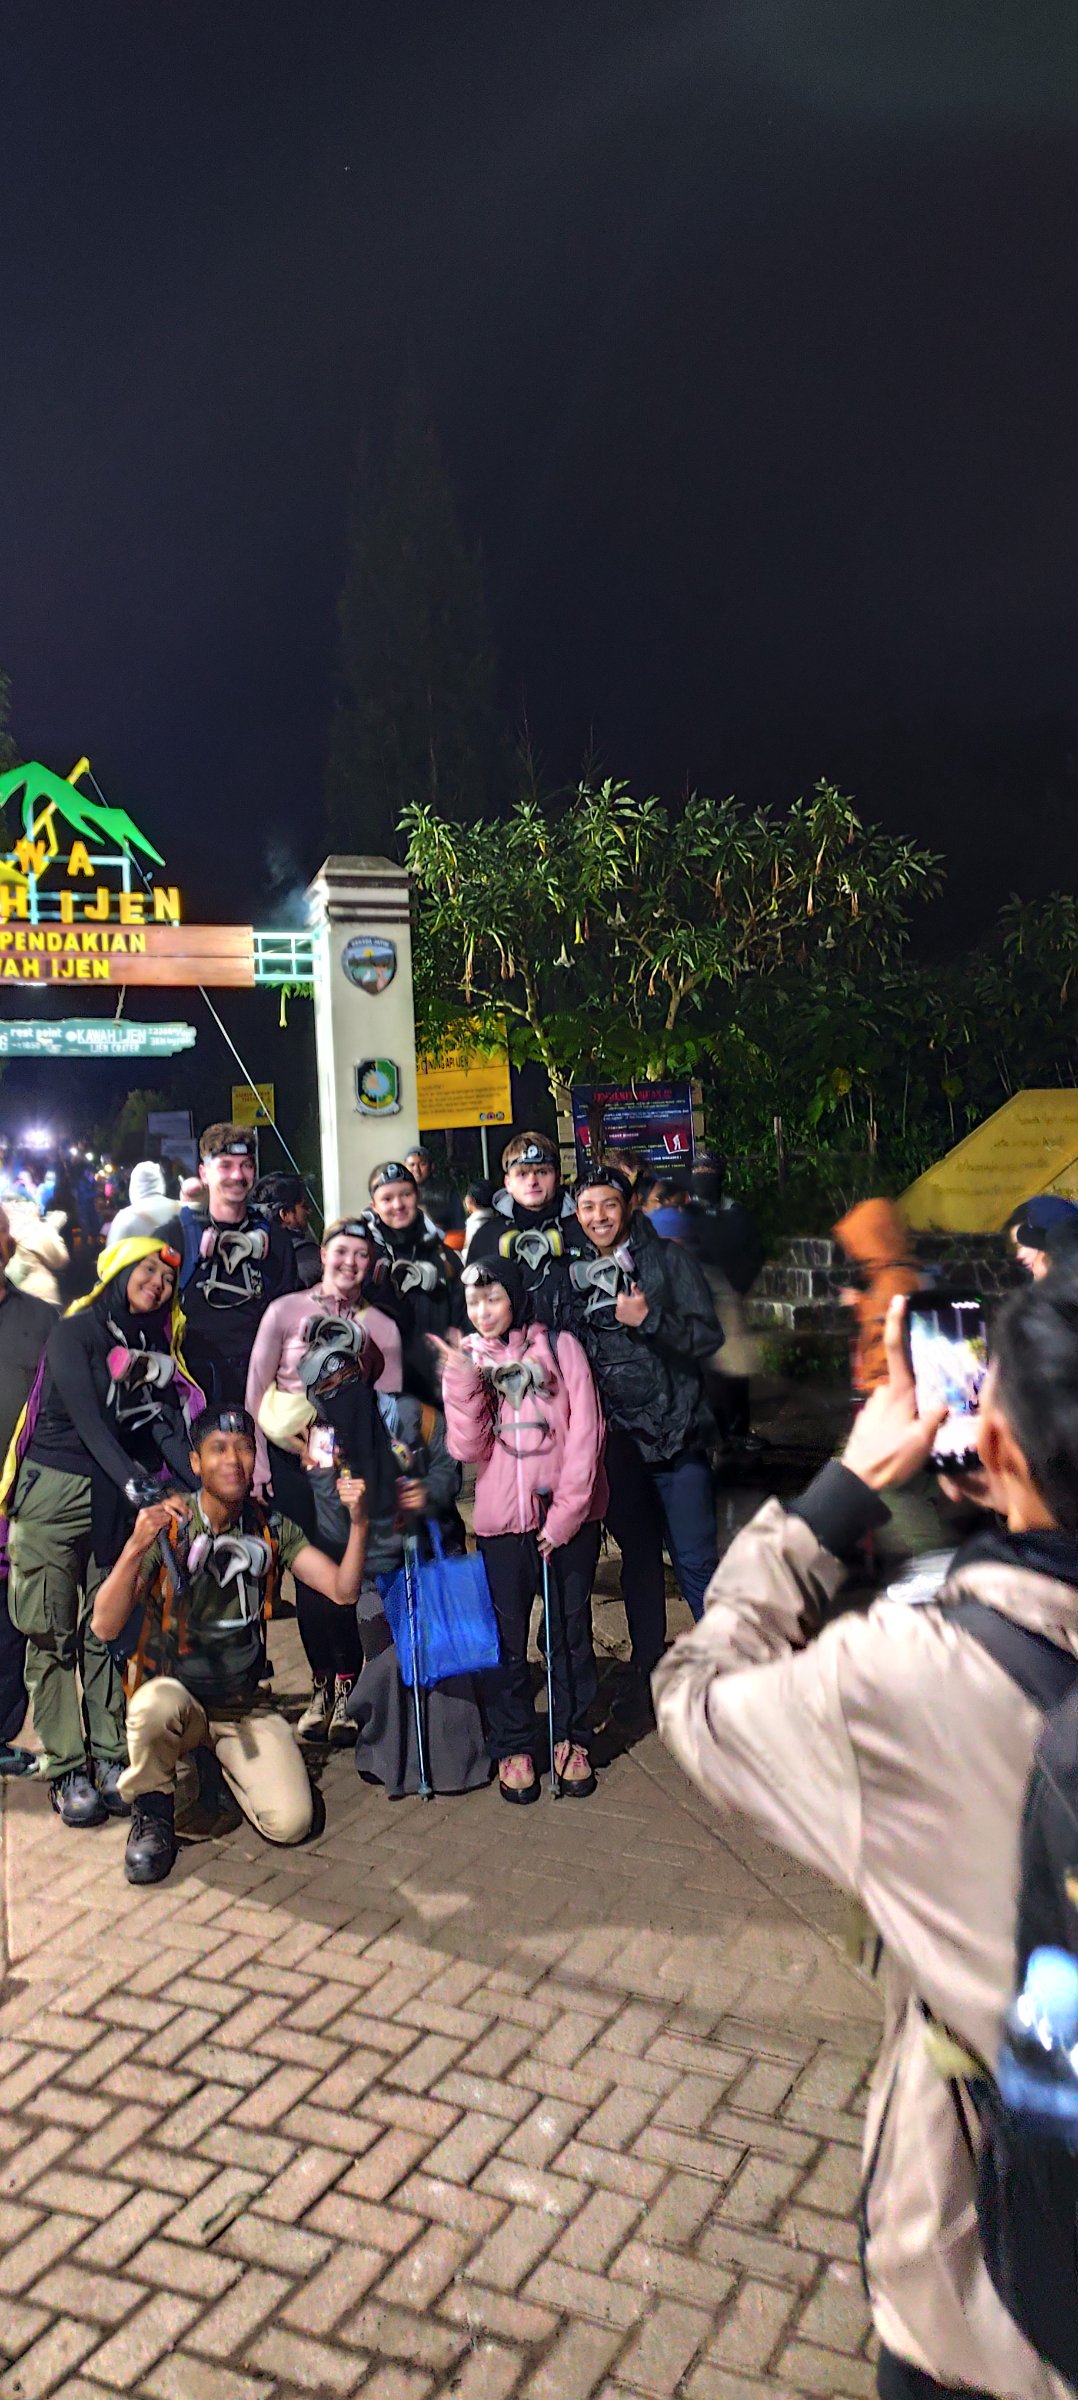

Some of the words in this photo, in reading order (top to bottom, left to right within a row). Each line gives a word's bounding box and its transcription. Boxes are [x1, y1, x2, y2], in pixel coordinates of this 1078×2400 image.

[60, 886, 180, 924] IJEN
[0, 931, 146, 952] PENDAKIAN
[51, 957, 109, 978] IJEN
[10, 1028, 34, 1038] rest
[36, 1028, 62, 1041] point
[77, 1029, 115, 1043] KAWAH
[119, 1029, 146, 1043] IJEN
